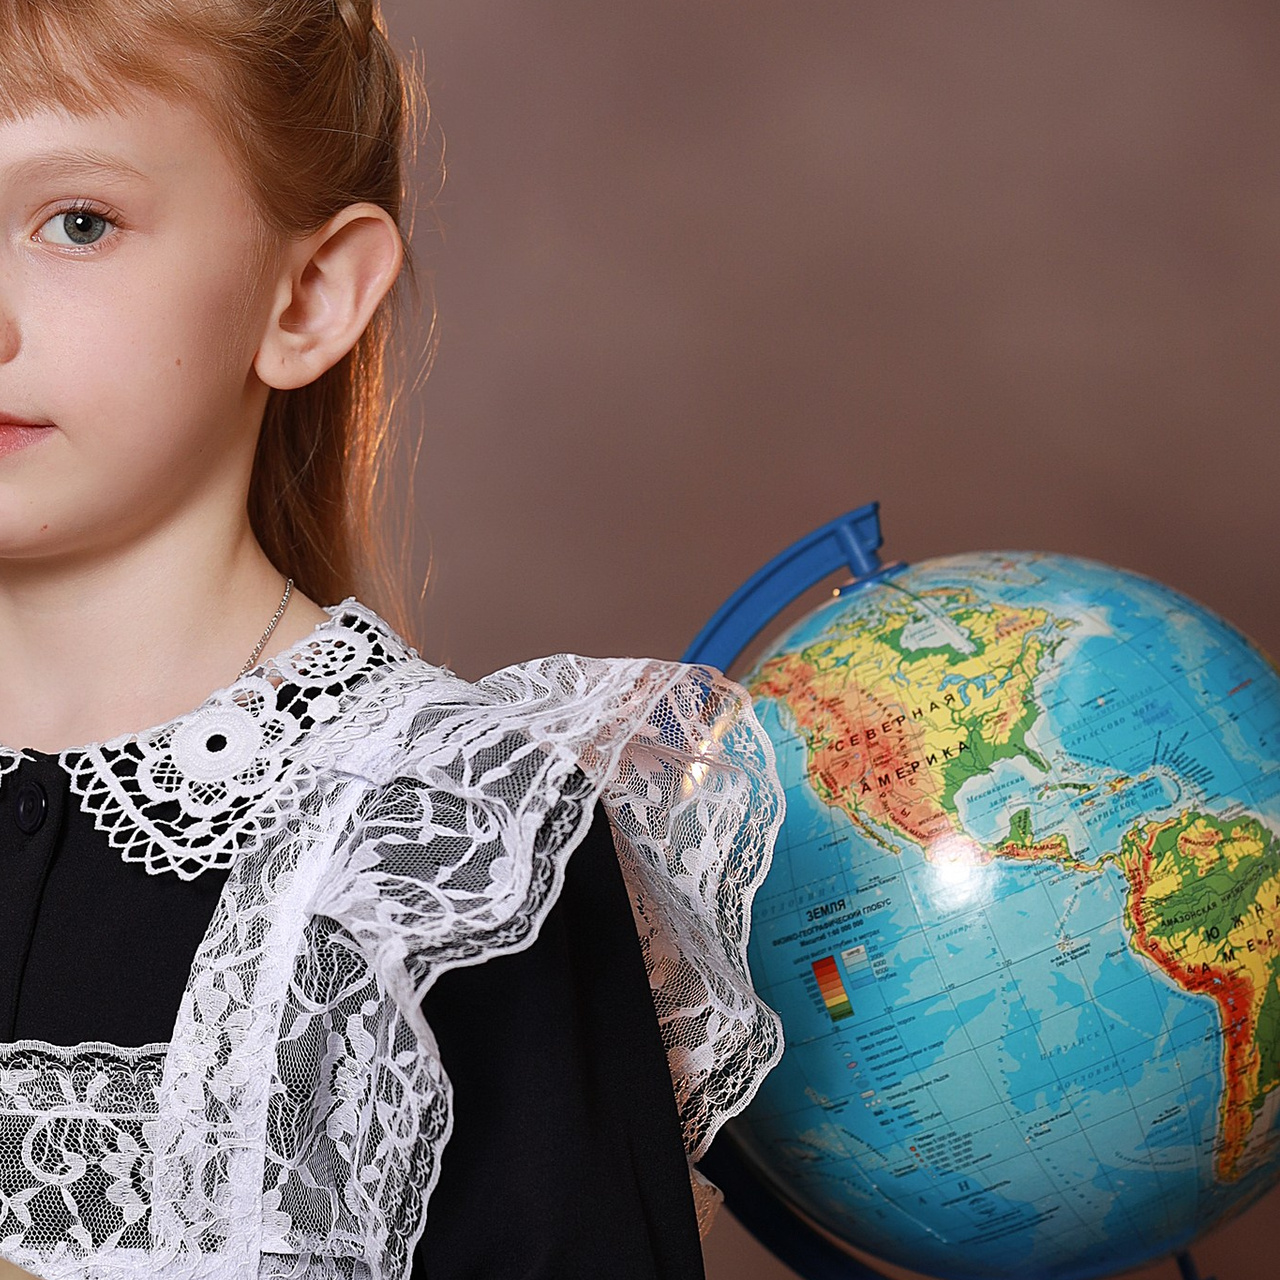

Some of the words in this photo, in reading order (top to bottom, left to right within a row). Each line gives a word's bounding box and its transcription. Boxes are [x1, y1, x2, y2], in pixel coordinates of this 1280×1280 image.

[835, 694, 956, 752] СЕВЕРНАЯ
[861, 741, 970, 794] АМЕРИКА
[1086, 799, 1137, 827] КАРИБСКОЕ
[806, 899, 846, 922] ЗЕМЛЯ
[862, 898, 892, 915] ГЛОБУС
[1160, 901, 1218, 928] АМАЗОНСКАЯ
[1201, 929, 1274, 975] АМЕР
